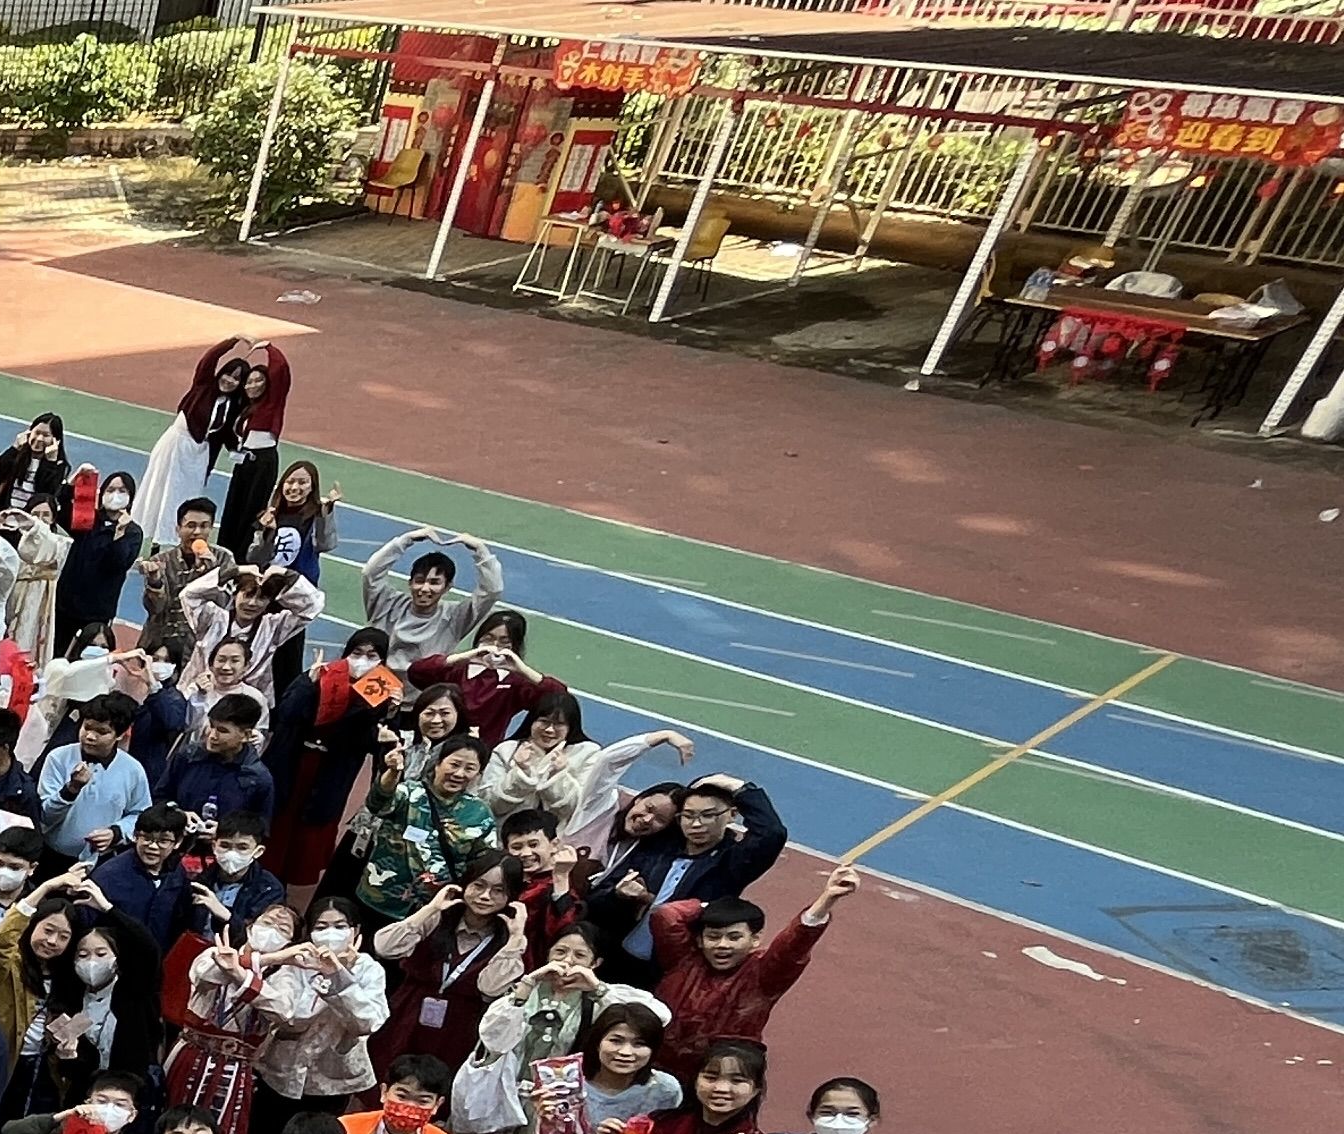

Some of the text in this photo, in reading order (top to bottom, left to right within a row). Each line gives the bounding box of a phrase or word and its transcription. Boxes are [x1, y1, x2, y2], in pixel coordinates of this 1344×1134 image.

[578, 62, 646, 88] 木射手
[1173, 121, 1284, 154] 迎春到
[274, 532, 295, 561] 兵
